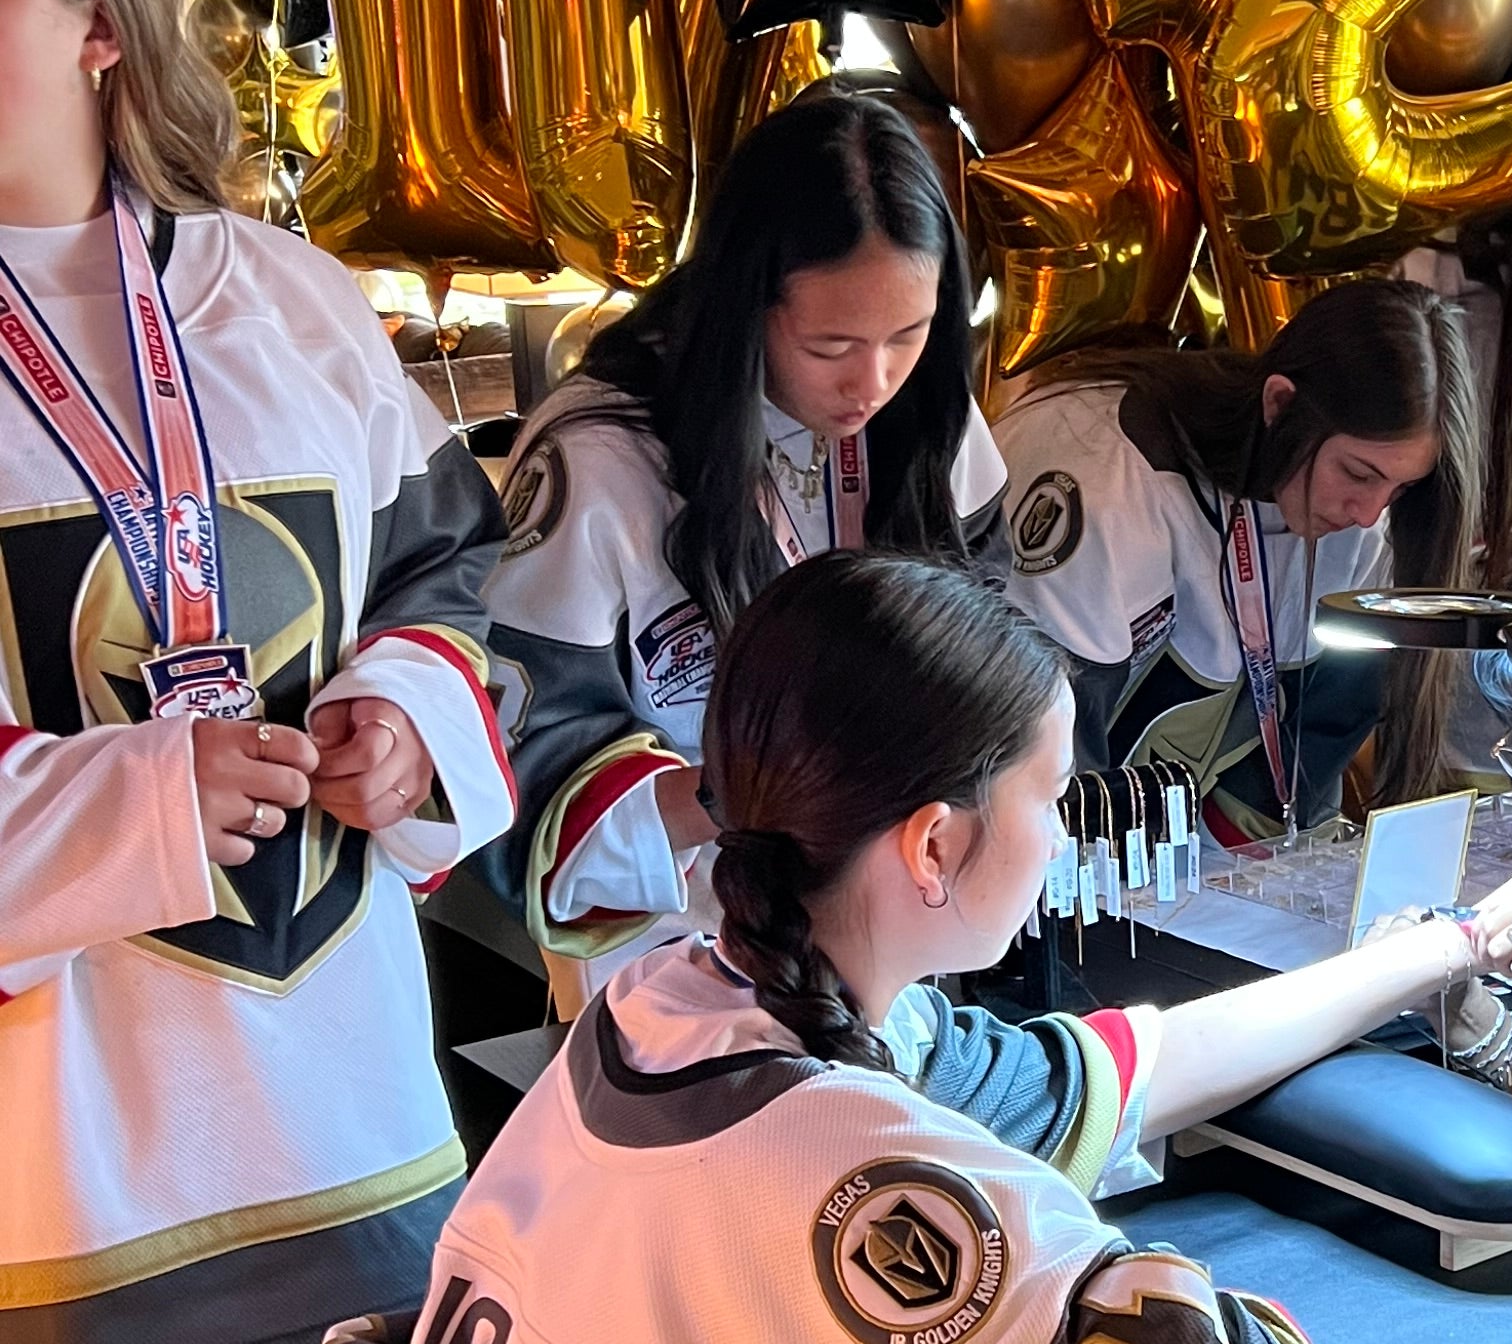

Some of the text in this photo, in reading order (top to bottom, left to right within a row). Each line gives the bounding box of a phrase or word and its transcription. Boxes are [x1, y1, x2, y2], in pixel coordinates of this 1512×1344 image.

[2, 319, 66, 402] CHIPOTLE
[139, 296, 168, 376] CHIPOTLE
[198, 509, 217, 590] HOCKEY
[1235, 518, 1251, 581] CHIPOTLE
[657, 645, 716, 687] HOCKE
[818, 1174, 871, 1228] VEGAS
[973, 1228, 1003, 1306] KNIGHTS
